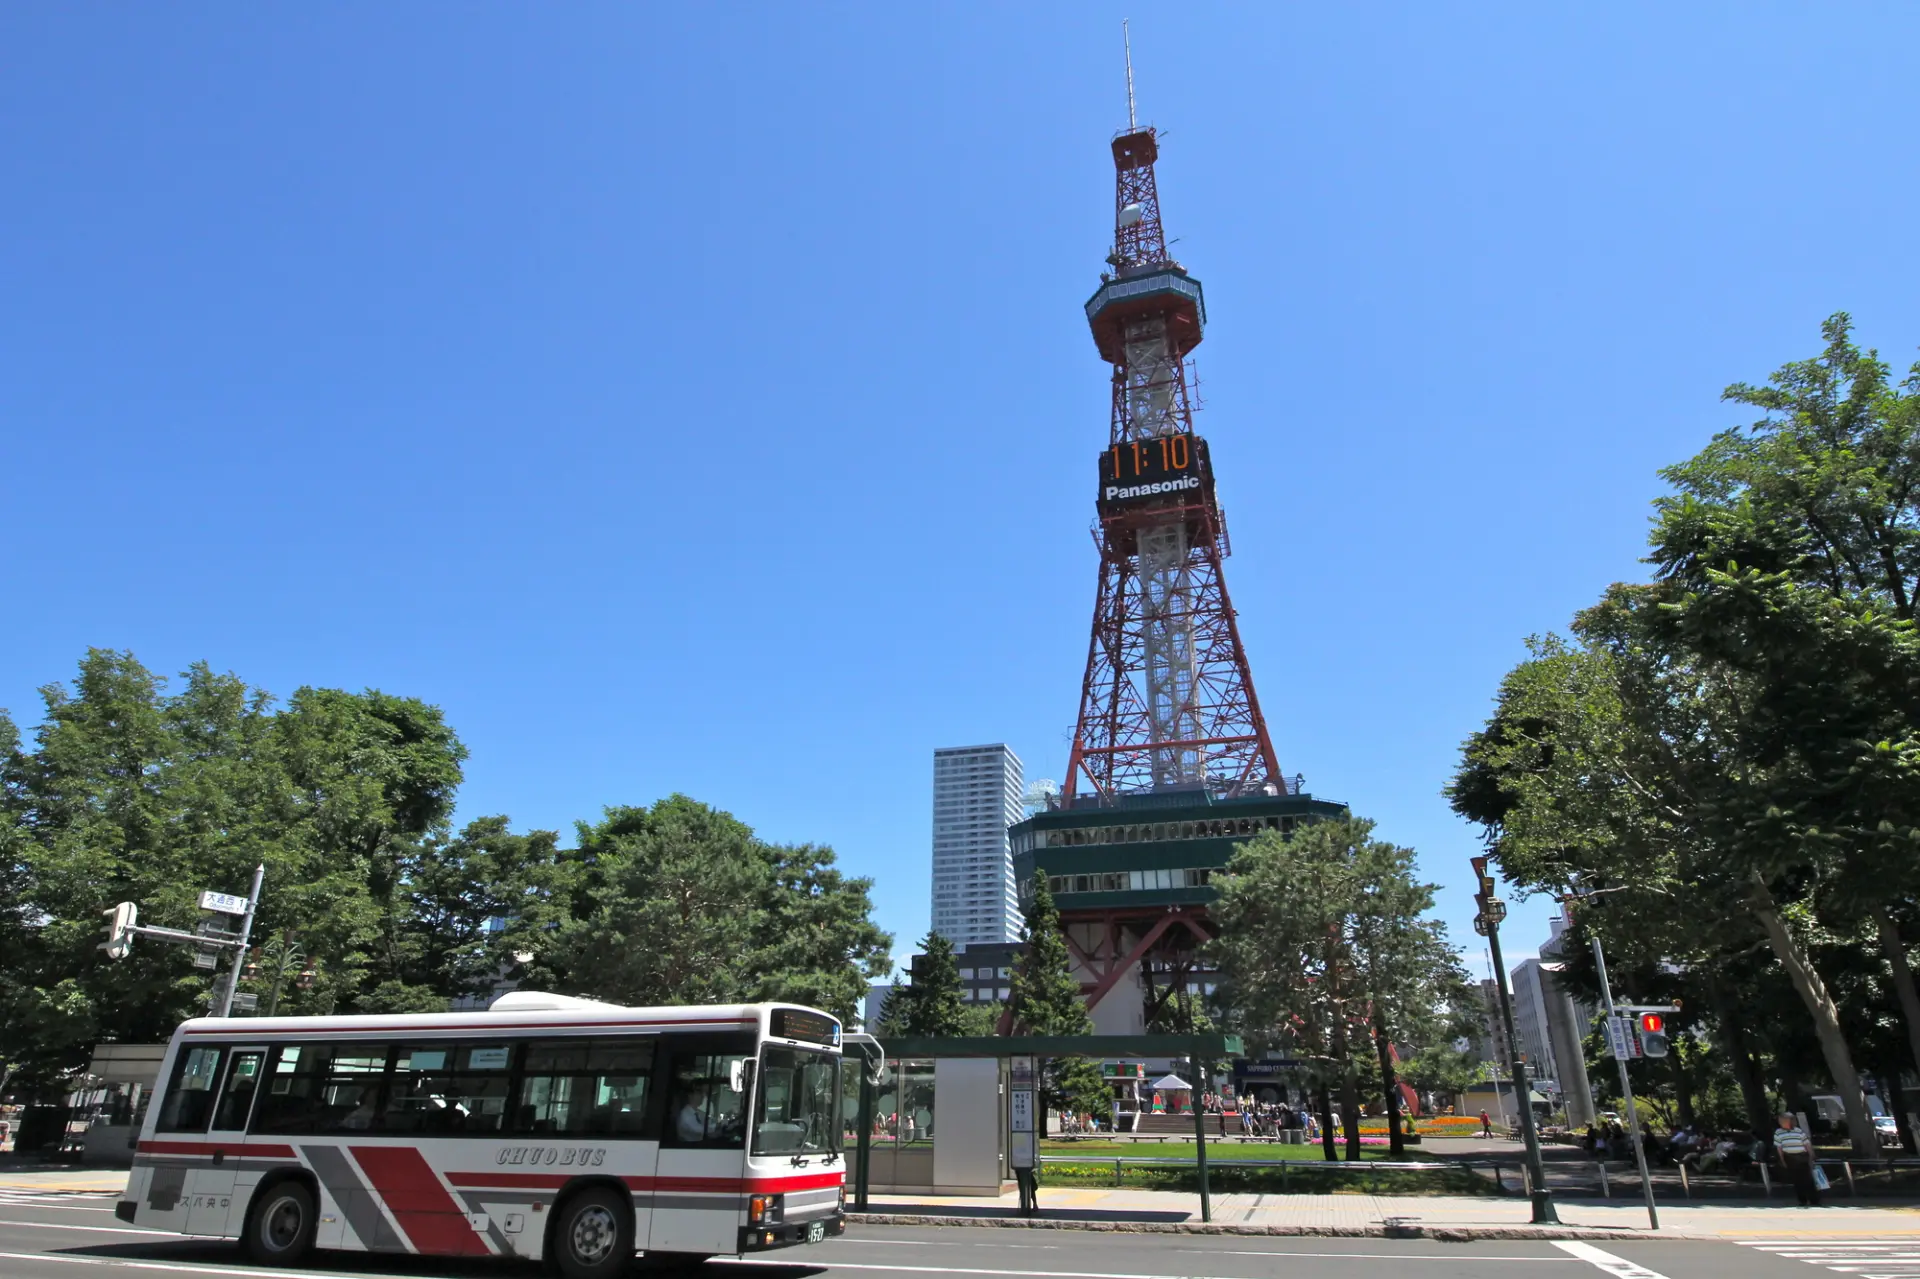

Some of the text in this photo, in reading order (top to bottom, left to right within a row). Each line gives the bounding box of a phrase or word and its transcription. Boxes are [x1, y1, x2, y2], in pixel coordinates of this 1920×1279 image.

[1106, 475, 1199, 501] Panasonic
[496, 1147, 607, 1167] CHUO BUS
